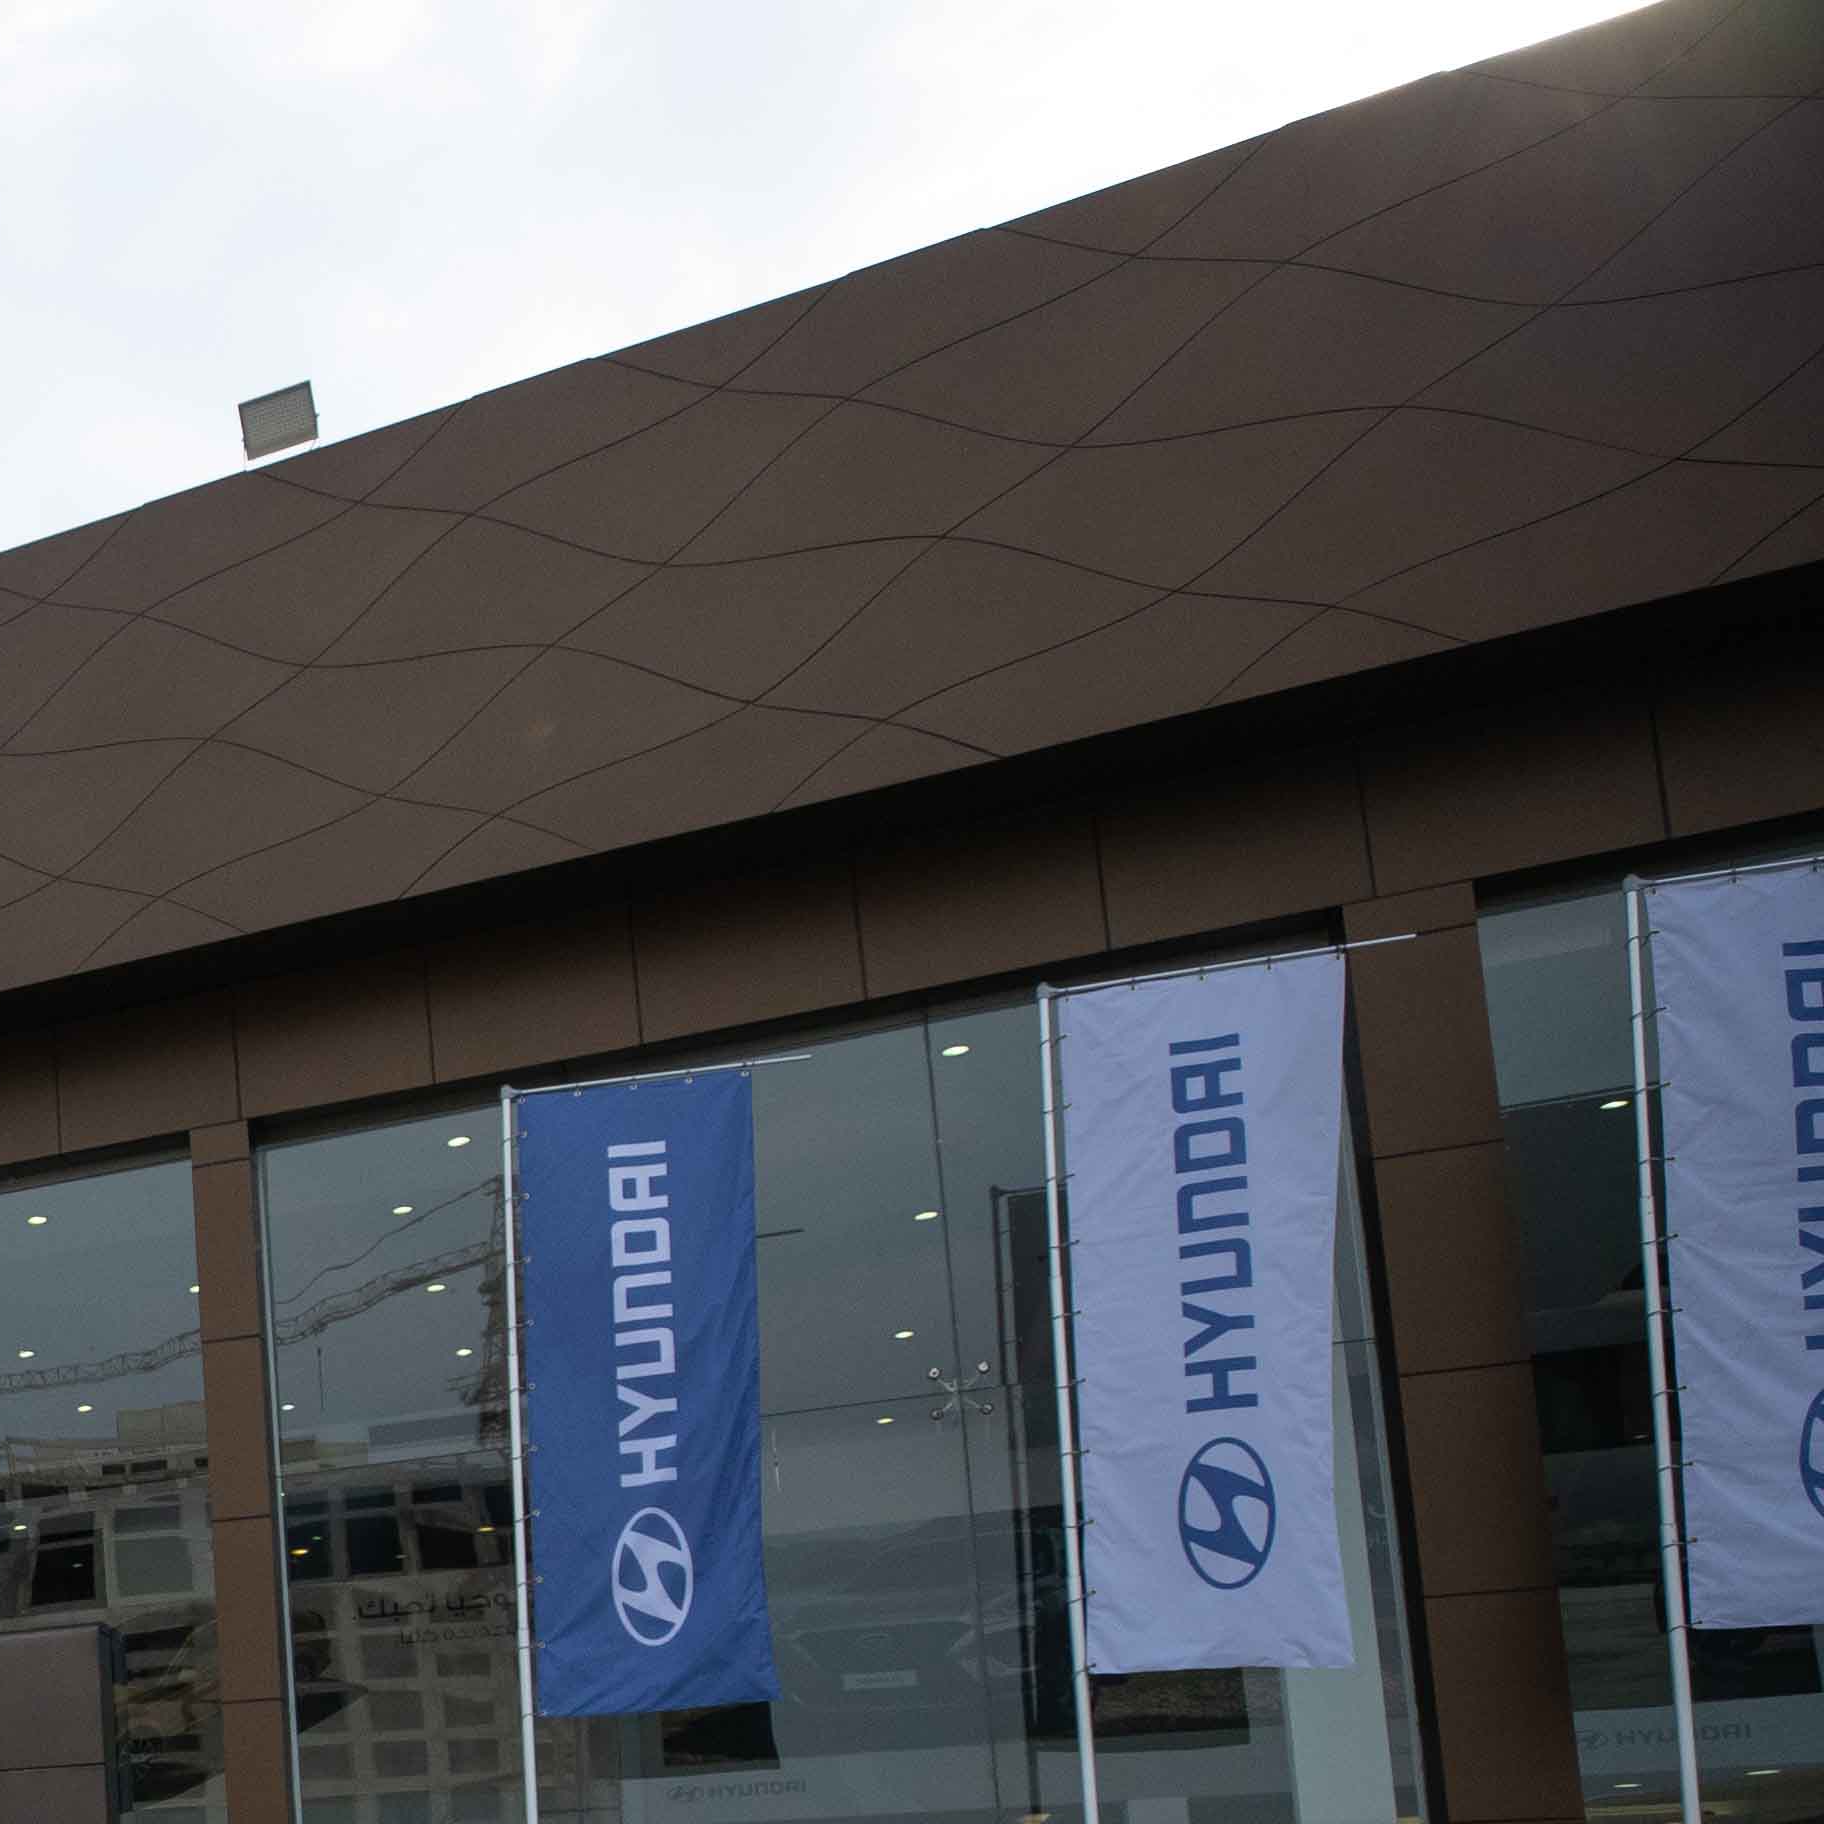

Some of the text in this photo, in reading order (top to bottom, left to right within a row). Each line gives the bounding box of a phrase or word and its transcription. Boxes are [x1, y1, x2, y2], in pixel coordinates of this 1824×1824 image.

[608, 1140, 678, 1488] HYUNDAI
[1168, 1032, 1260, 1414] HYUNDAI
[708, 1779, 807, 1799] HYUNDAI
[1616, 1723, 1752, 1744] HYUDAI
